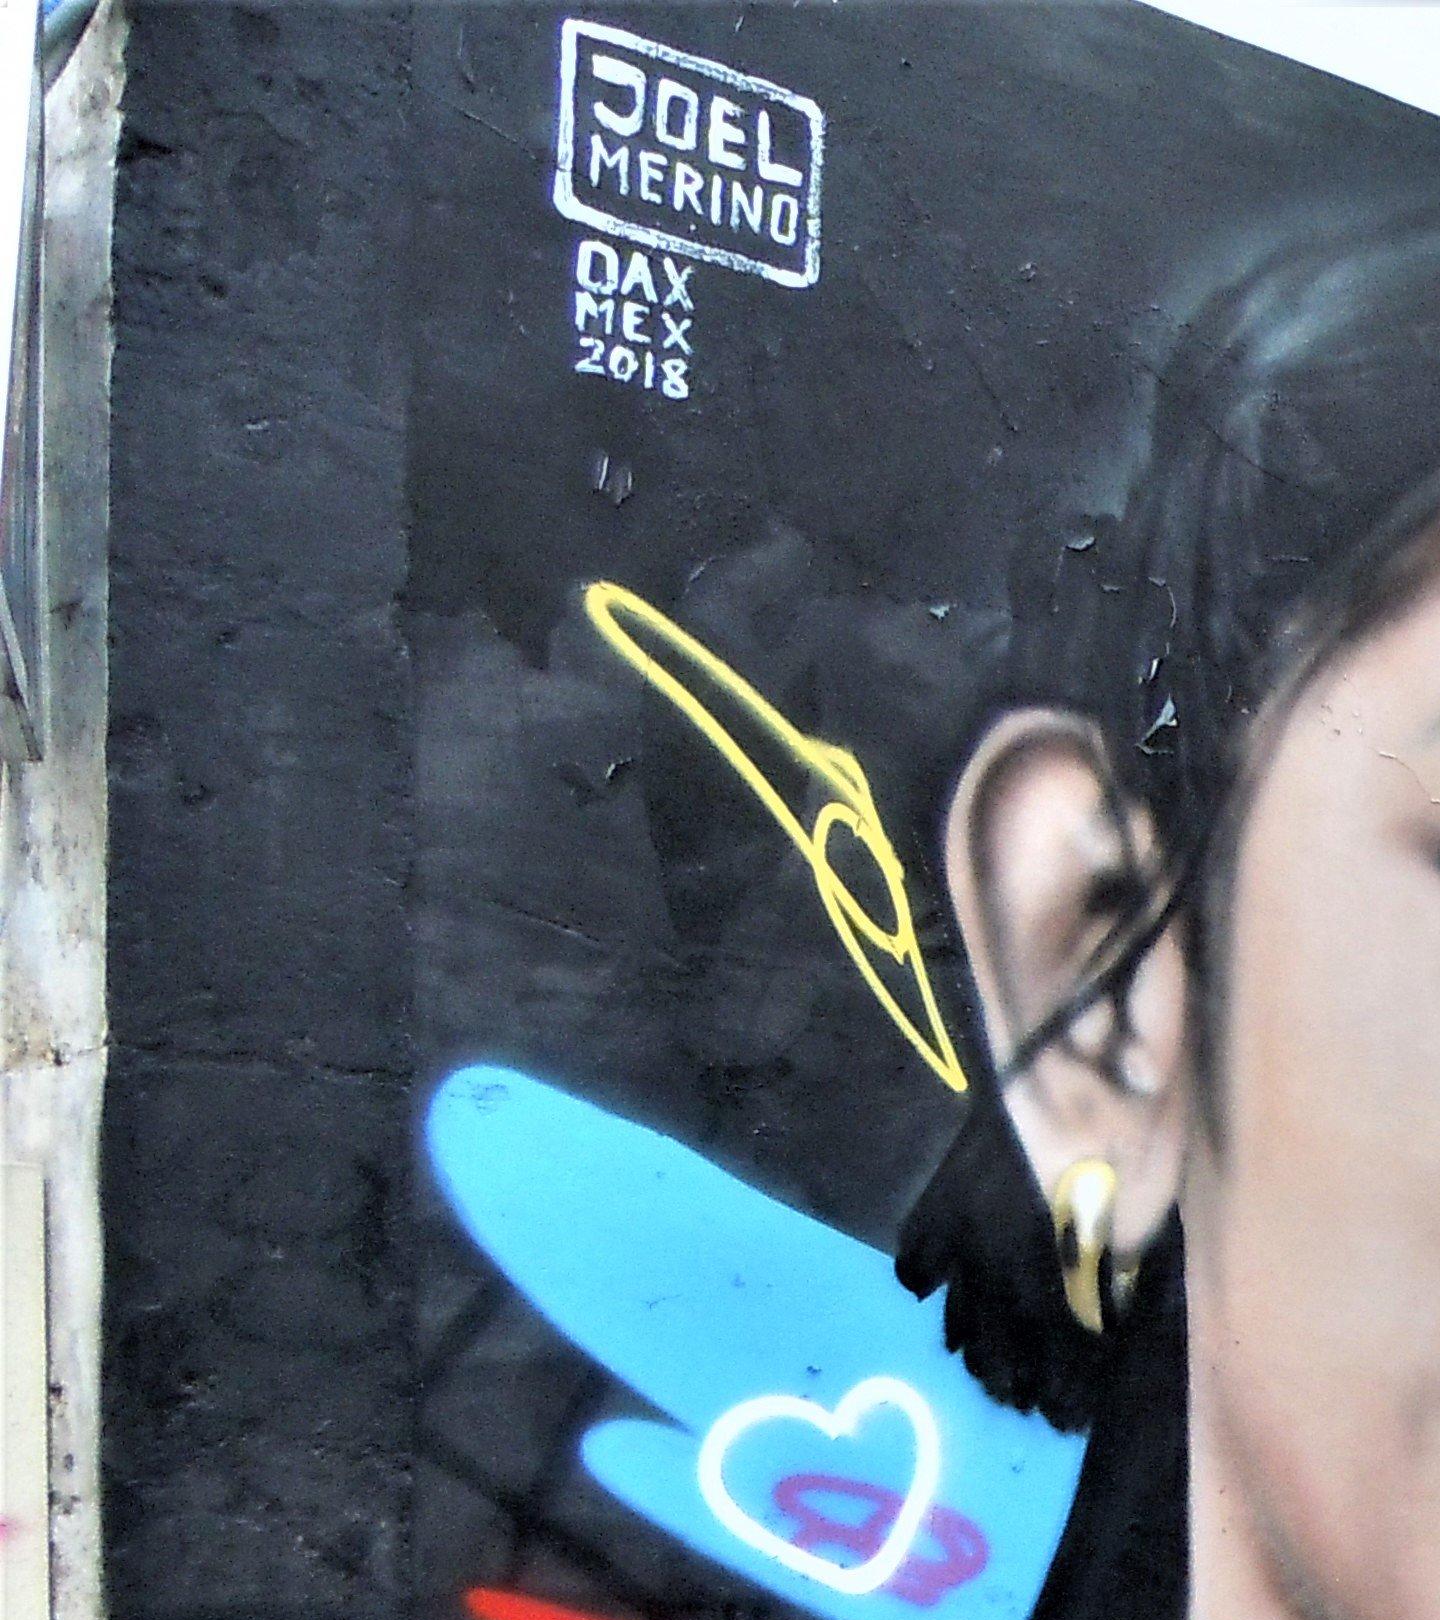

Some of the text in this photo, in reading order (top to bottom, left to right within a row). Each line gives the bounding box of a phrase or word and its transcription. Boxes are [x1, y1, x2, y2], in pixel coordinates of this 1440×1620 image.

[592, 54, 802, 187] JOEL
[589, 134, 799, 246] MERINO
[576, 240, 694, 311] OAX
[574, 291, 692, 355] MEX
[574, 338, 690, 399] 2018
